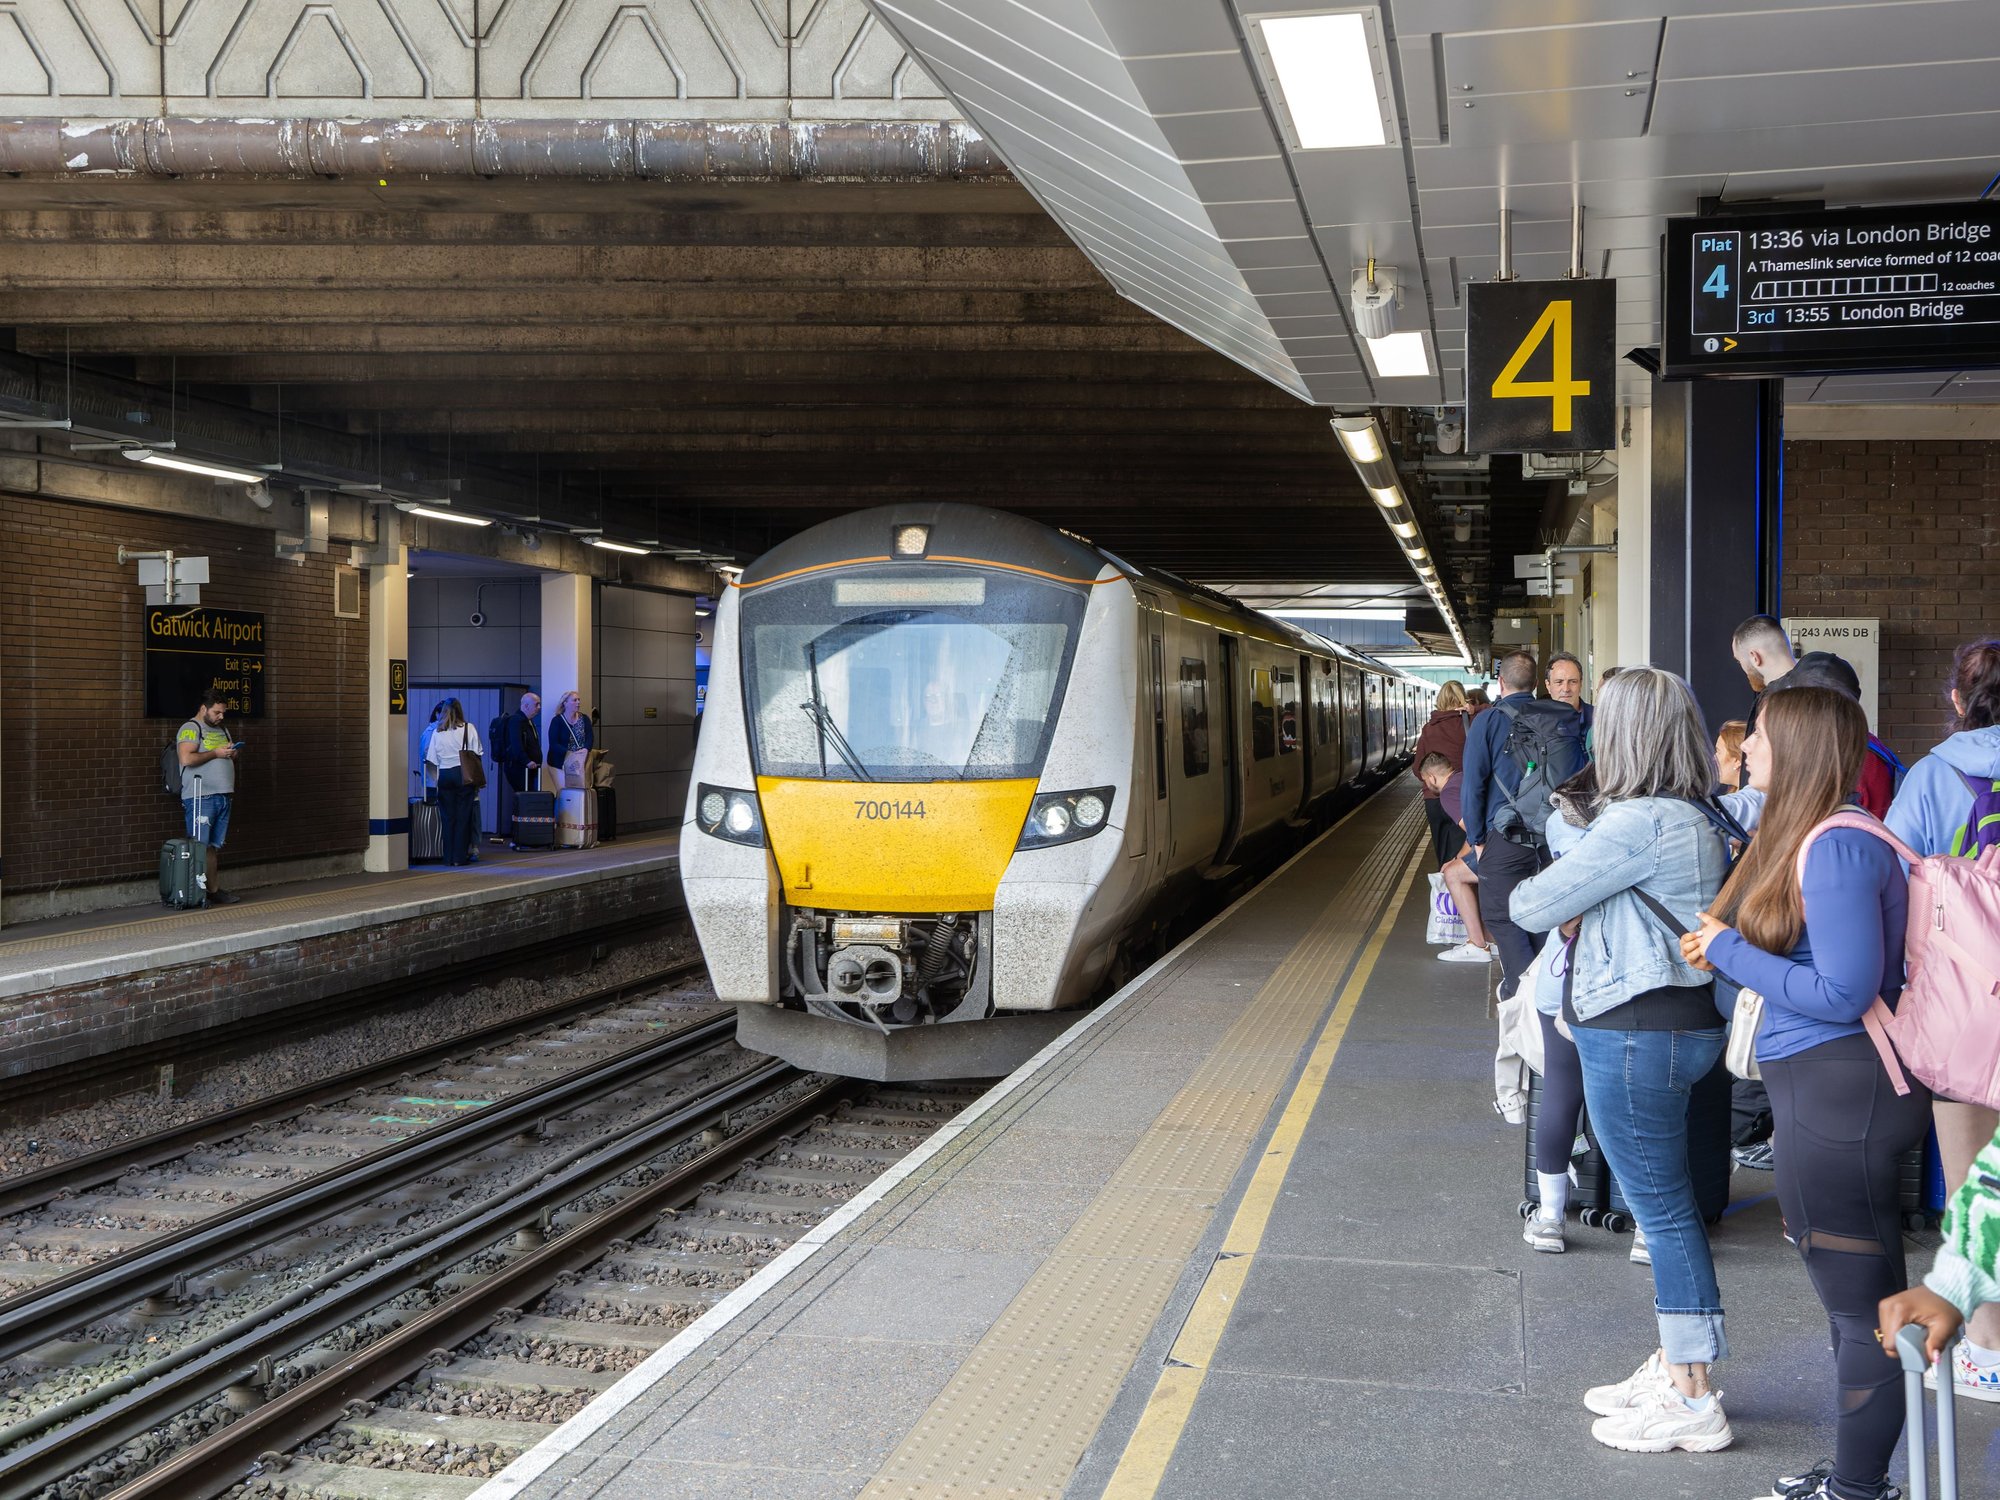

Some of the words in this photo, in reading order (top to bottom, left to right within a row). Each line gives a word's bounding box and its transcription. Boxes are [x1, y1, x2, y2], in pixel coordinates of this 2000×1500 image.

[1749, 230, 1804, 250] 13:36
[1811, 228, 1839, 246] via
[1846, 224, 1920, 245] London
[1927, 221, 1991, 243] Bridge
[1701, 238, 1732, 252] Plat
[1747, 261, 1757, 273] A
[1760, 256, 1833, 272] Thameslink
[1836, 255, 1882, 269] service
[1885, 251, 1934, 266] formed
[1937, 250, 1952, 264] of
[1955, 250, 1971, 263] 12
[1702, 264, 1730, 299] 4
[1942, 282, 1954, 292] 12
[1955, 280, 1995, 291] coaches
[1747, 308, 1776, 325] 3rd
[1785, 306, 1830, 323] 13:55
[1841, 303, 1905, 321] London
[1909, 301, 1964, 320] Bridge
[1491, 299, 1591, 432] 4
[150, 611, 210, 638] Gatwick
[212, 616, 262, 646] Airport
[1801, 627, 1820, 638] 243
[1823, 627, 1850, 638] AWS
[1853, 628, 1869, 638] DB
[225, 657, 240, 671] Exit
[212, 677, 240, 692] Airport
[179, 729, 196, 741] JPN
[854, 801, 926, 819] 700144
